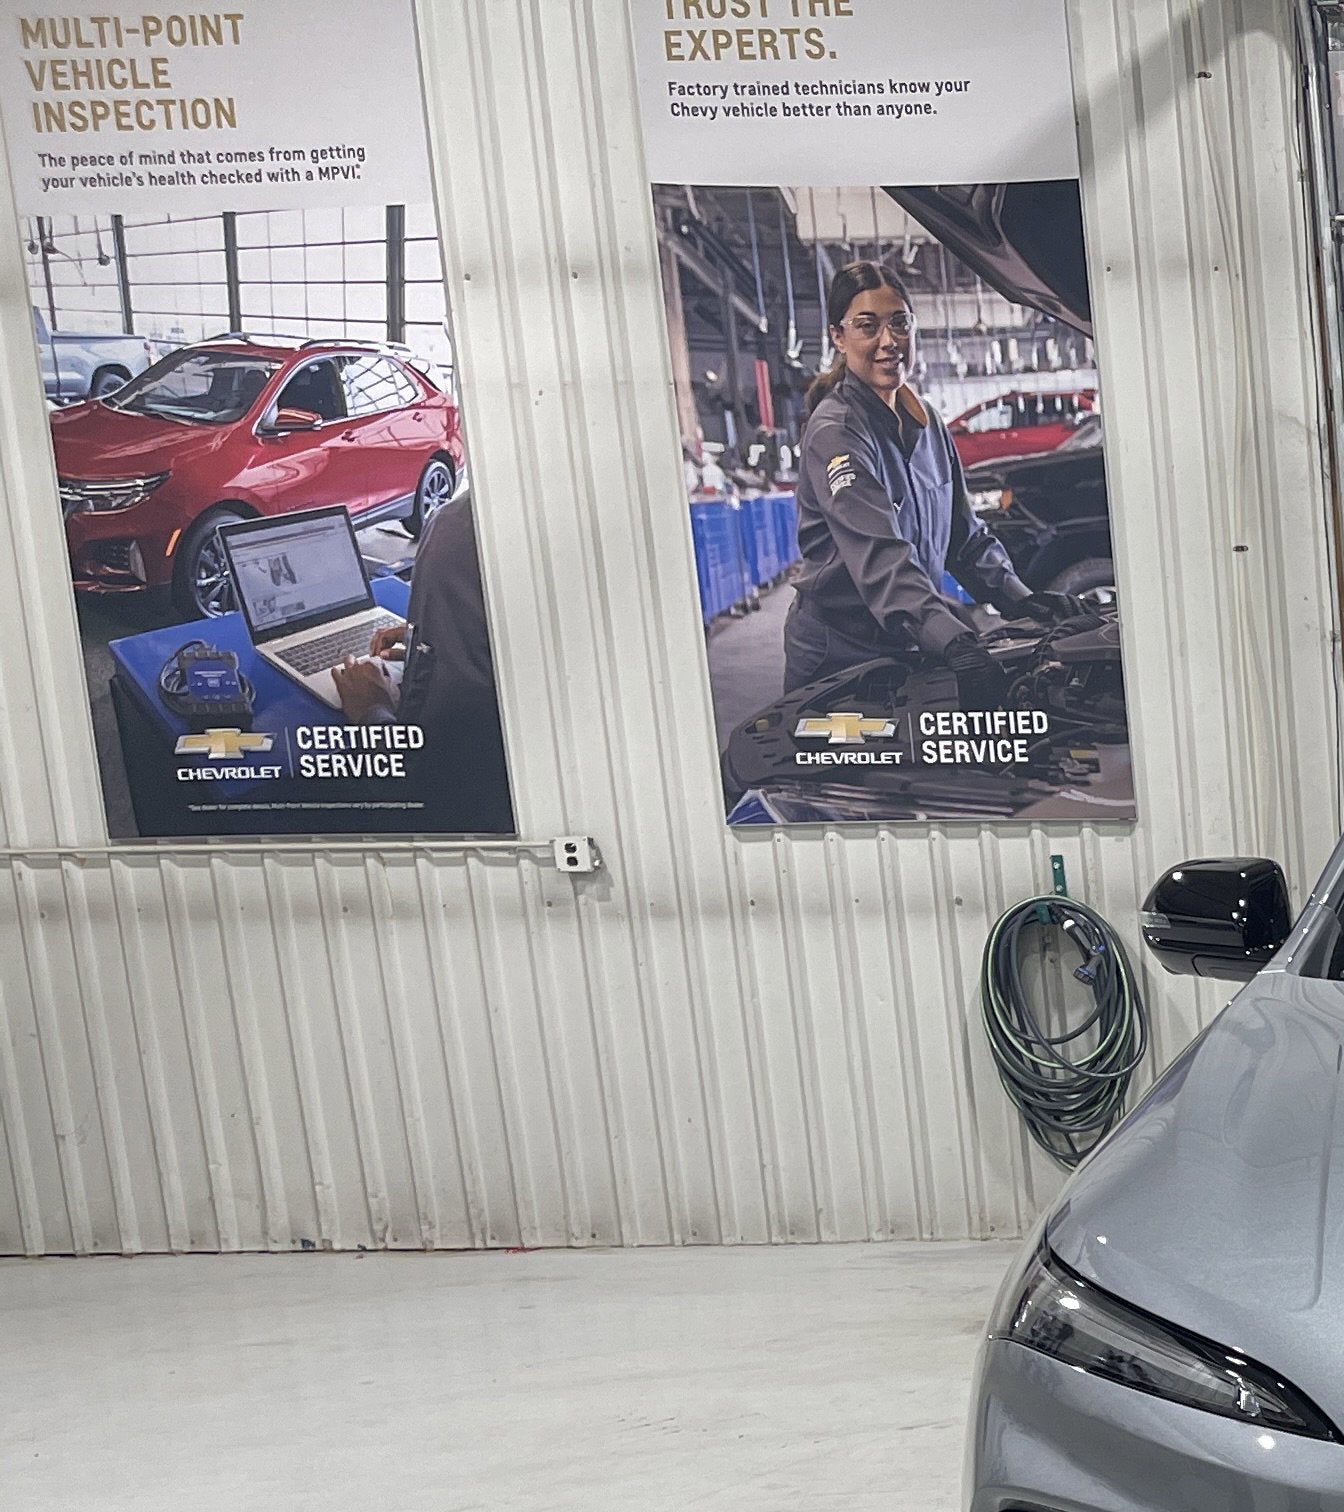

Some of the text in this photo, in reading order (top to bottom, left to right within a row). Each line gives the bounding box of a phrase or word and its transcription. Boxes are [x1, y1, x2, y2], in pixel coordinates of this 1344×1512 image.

[665, 0, 854, 20] TRUST THE
[20, 13, 244, 49] MULTI-POINT
[664, 27, 838, 62] EXPERTS.
[24, 57, 172, 92] VEHICLE
[668, 79, 971, 100] Factory trained technicians know your
[32, 97, 238, 133] INSPECTION
[671, 101, 937, 120] Chevy vehicle better than anyone.
[38, 145, 366, 171] The peace of mind that comes from getting
[41, 176, 75, 193] your
[79, 171, 145, 188] vehicle's
[149, 171, 197, 186] health
[200, 169, 262, 185] checked
[267, 167, 301, 183] with
[305, 170, 314, 182] a
[919, 710, 1048, 736] CERTIFIED
[296, 725, 424, 750] CERTIFIED
[795, 751, 903, 765] CHEVROLET
[922, 739, 1029, 764] SERVICE
[176, 766, 282, 781] CHEVROLET
[299, 754, 406, 778] SERVICE
